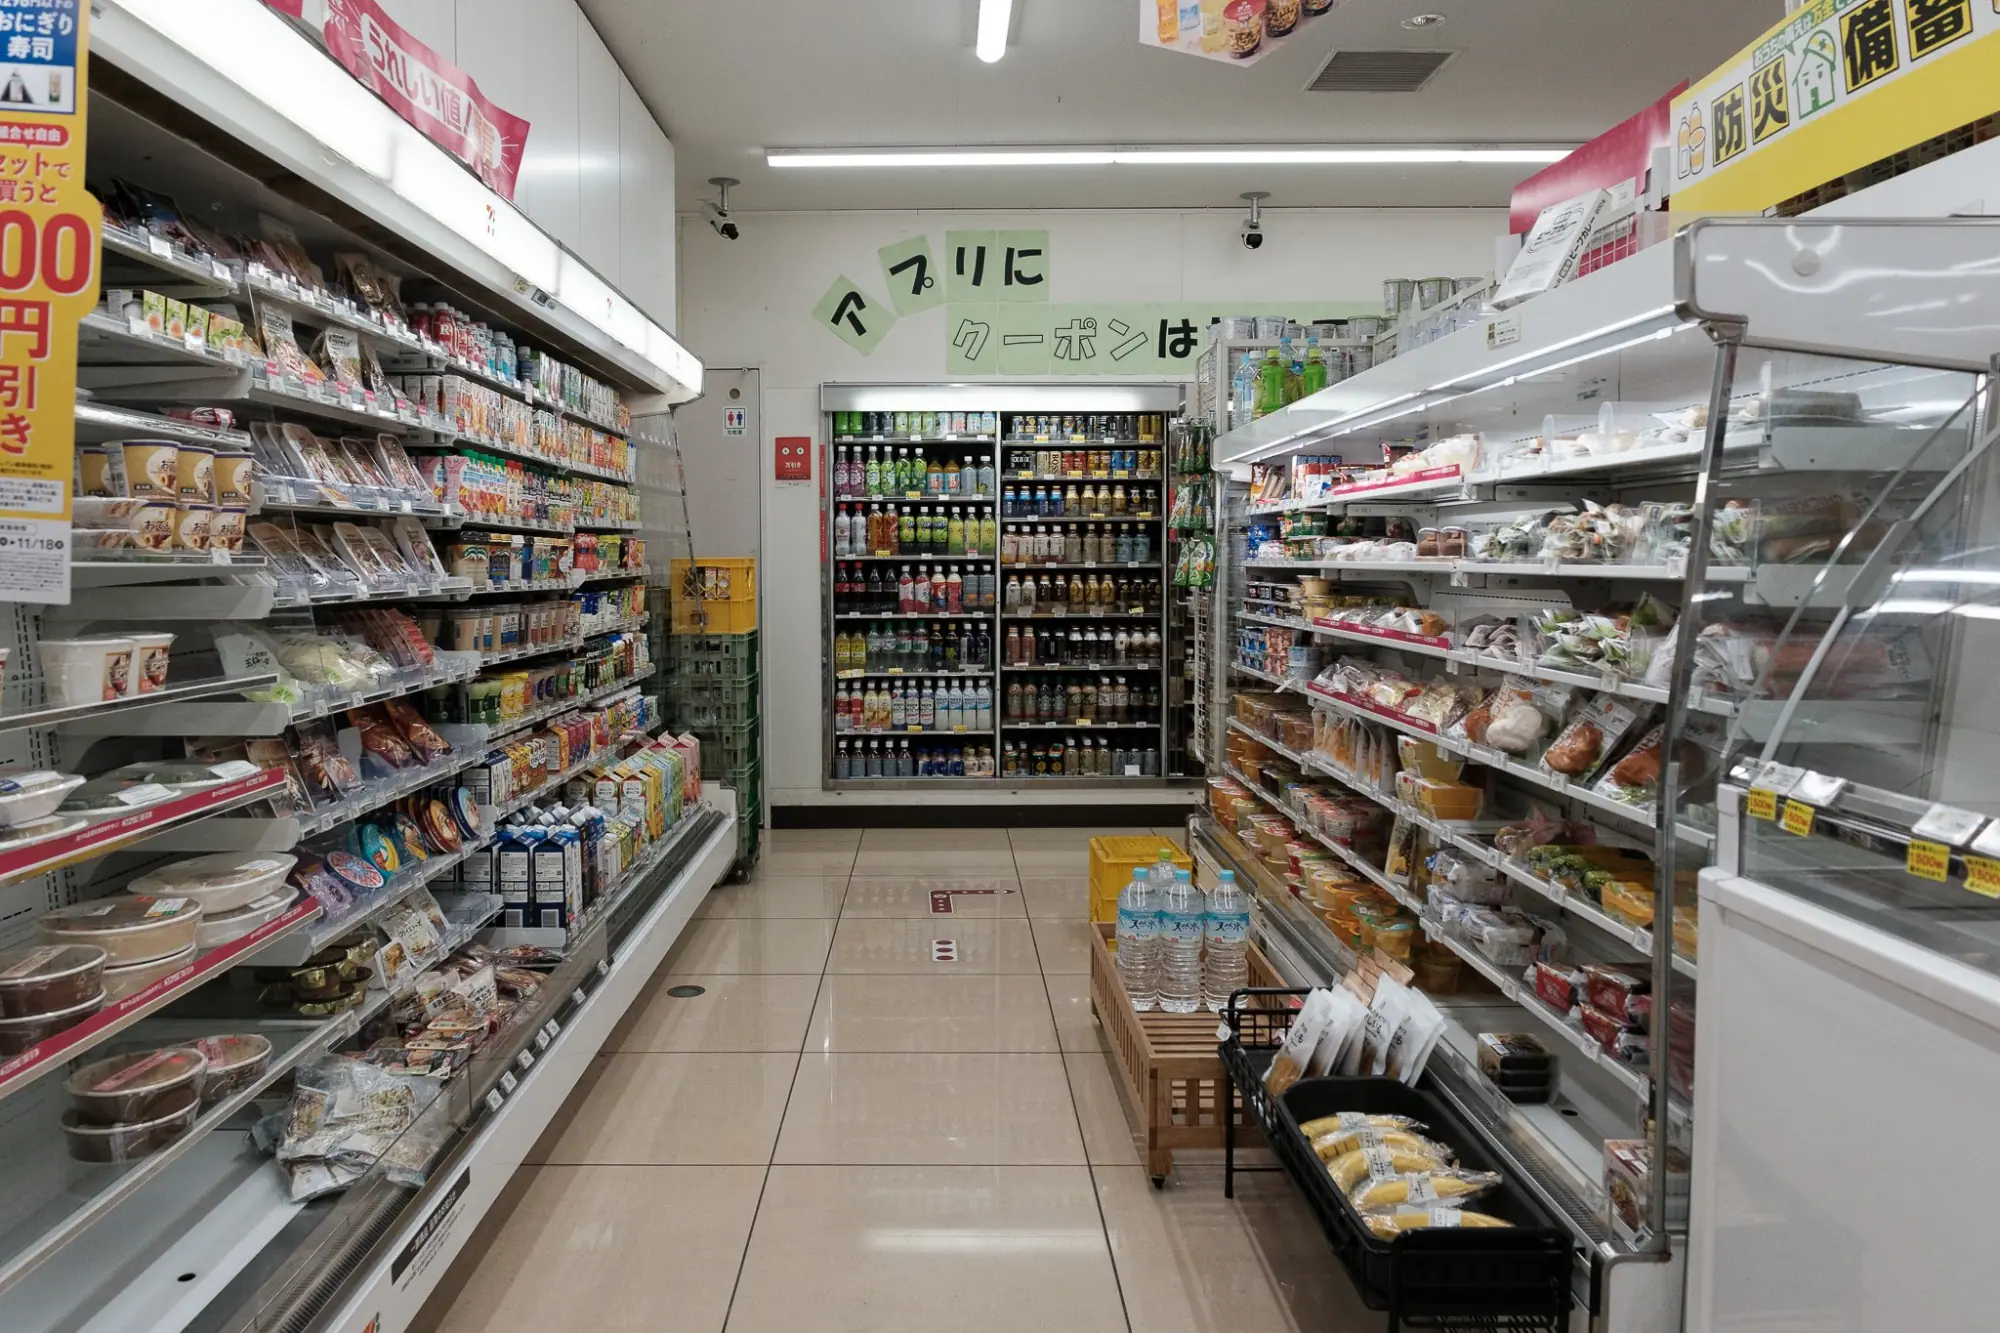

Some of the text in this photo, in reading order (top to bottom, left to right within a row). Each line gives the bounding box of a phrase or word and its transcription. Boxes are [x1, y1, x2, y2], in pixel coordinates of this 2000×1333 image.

[0, 11, 73, 36] おにぎり
[7, 35, 54, 61] 寿司
[1712, 58, 1789, 162] 防災
[1569, 216, 1596, 260] ビーフカレー
[831, 246, 1045, 338] アプリに
[1129, 918, 1158, 930] 天然水
[1172, 920, 1201, 932] 天然水
[1215, 920, 1244, 932] 天然水
